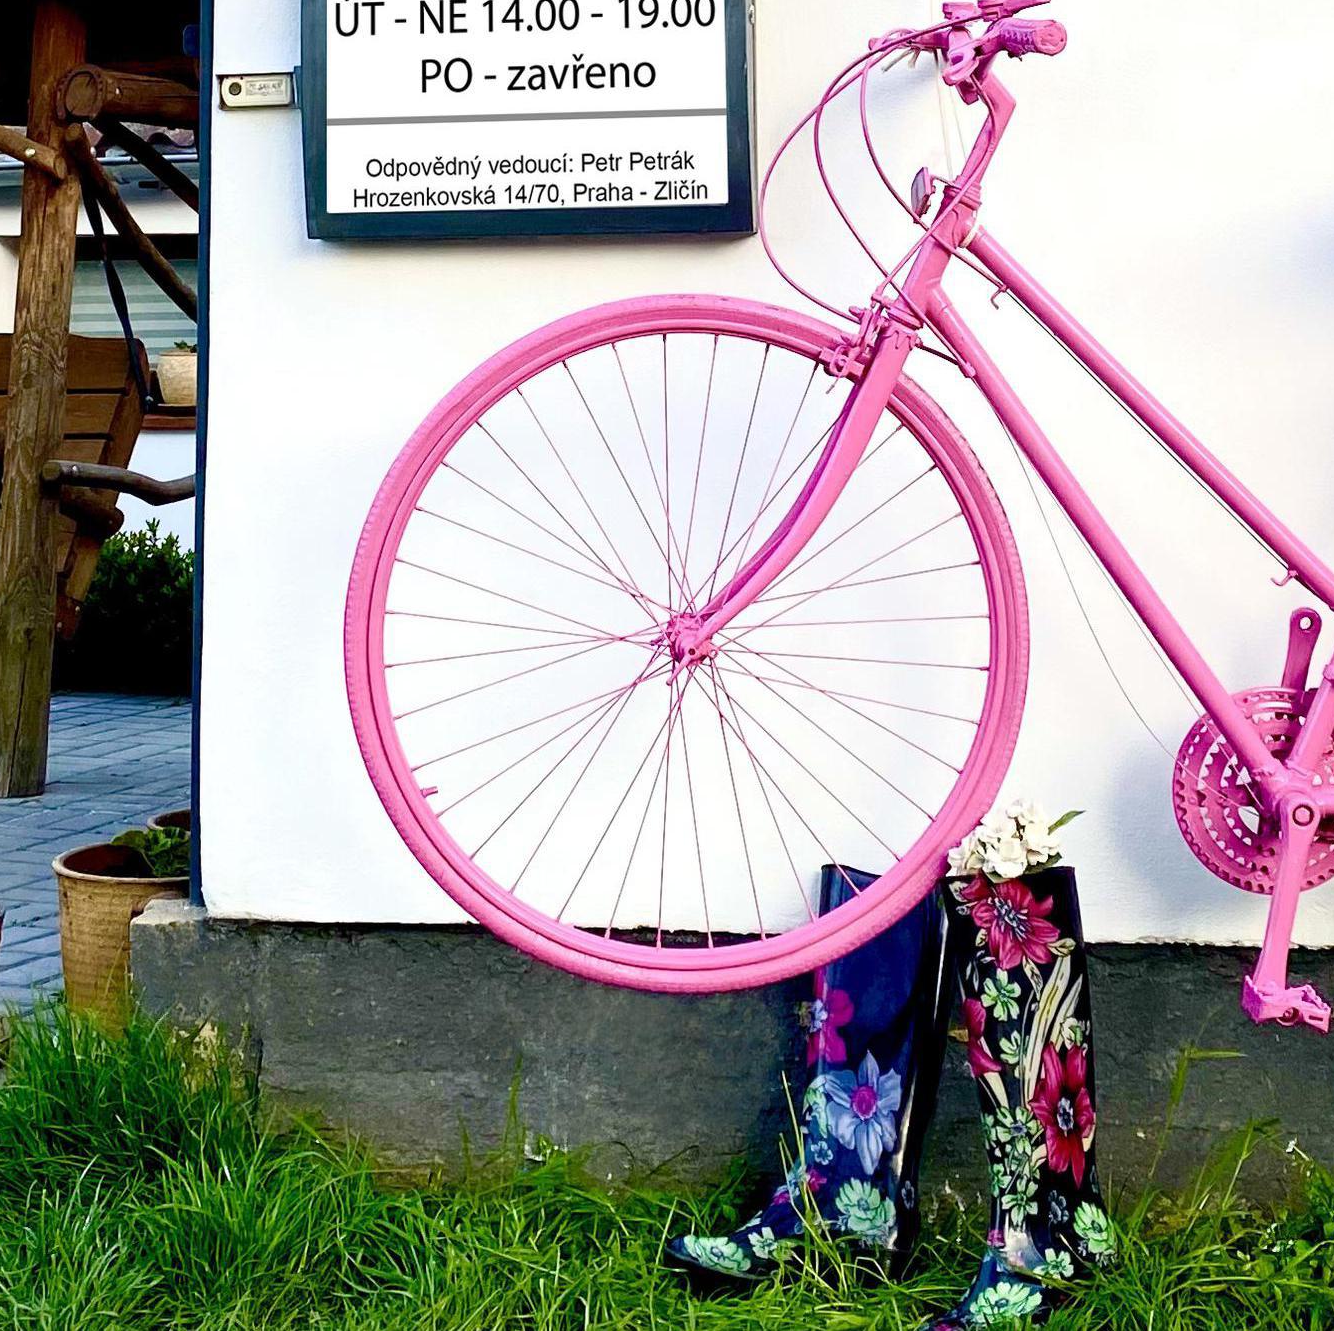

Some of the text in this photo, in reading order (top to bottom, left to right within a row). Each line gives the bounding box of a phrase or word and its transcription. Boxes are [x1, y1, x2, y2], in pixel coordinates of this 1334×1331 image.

[421, 57, 473, 94] PO
[506, 53, 656, 91] zavřeno
[365, 150, 695, 182] Odpovědný vedoucí: Petr Petrák
[353, 185, 496, 208] Hrozenkovská
[504, 183, 565, 206] 14/70,
[573, 182, 634, 203] Praha
[653, 179, 709, 201] Zličín
